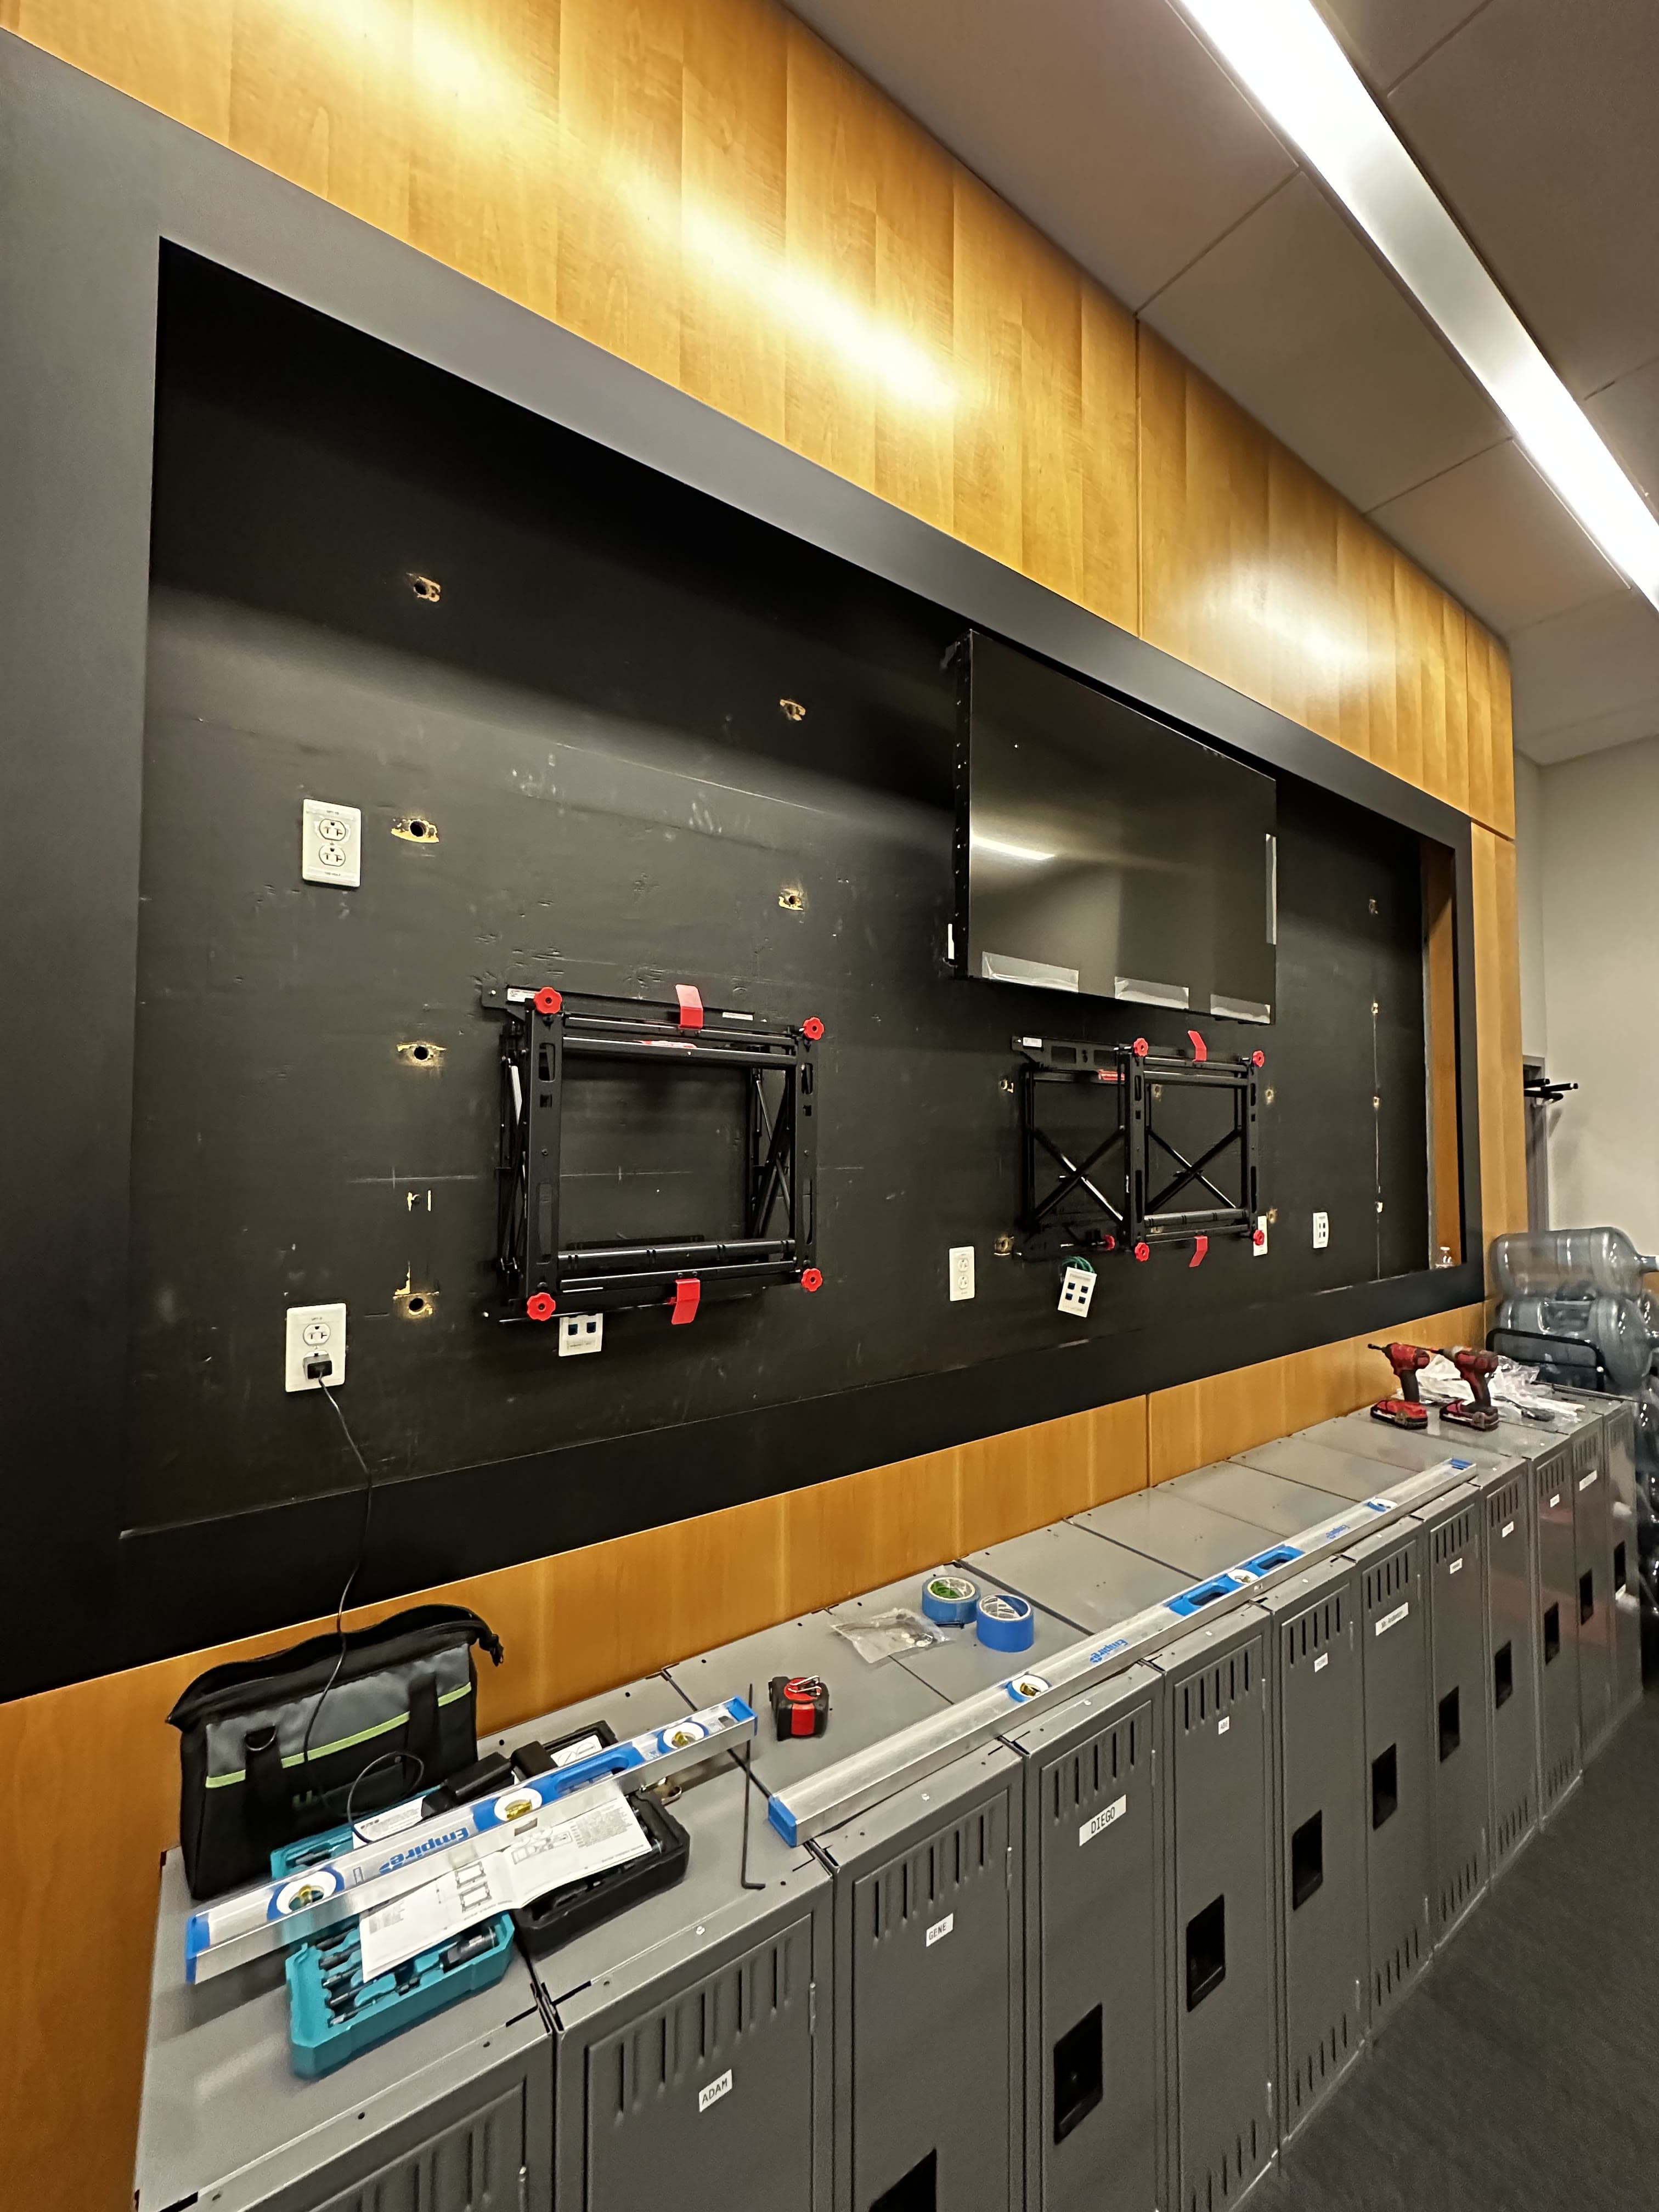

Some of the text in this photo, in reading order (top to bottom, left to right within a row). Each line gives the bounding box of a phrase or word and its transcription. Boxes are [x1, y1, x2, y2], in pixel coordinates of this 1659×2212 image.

[1091, 1806, 1115, 1835] DIEGO
[388, 1827, 469, 1865] Empire
[928, 1922, 947, 1940] GENE
[702, 2077, 728, 2106] ADAM
